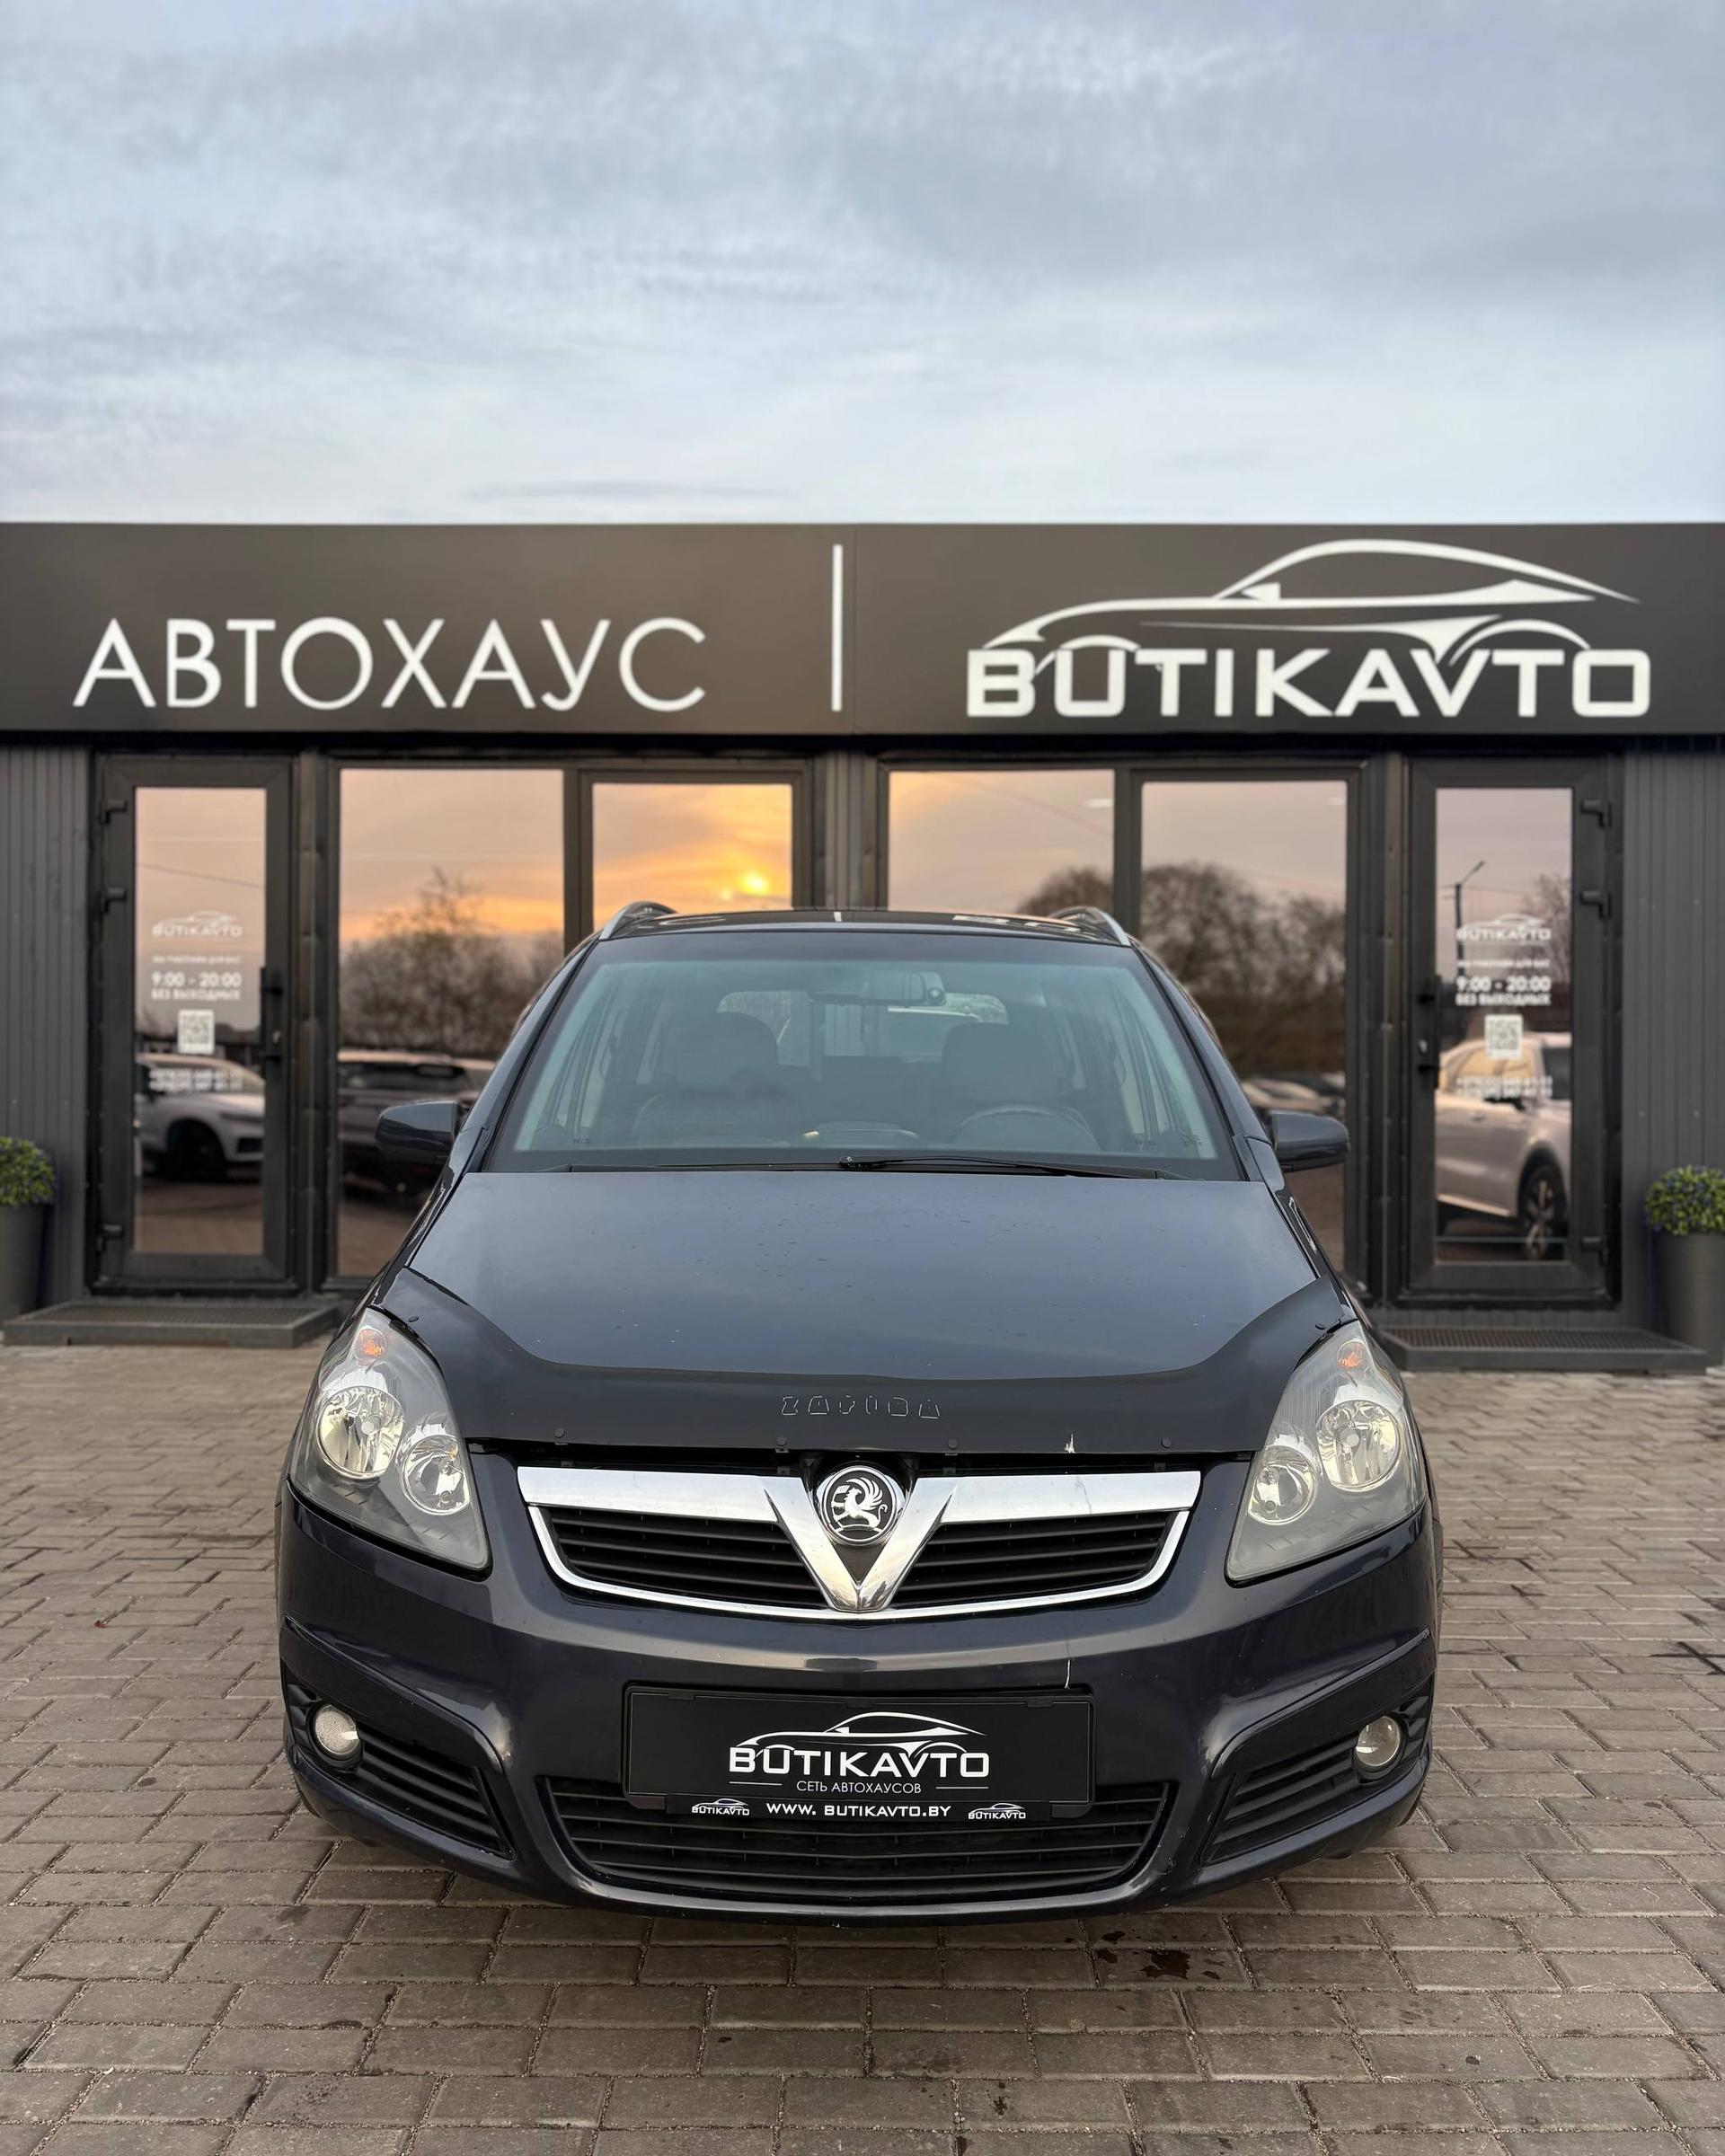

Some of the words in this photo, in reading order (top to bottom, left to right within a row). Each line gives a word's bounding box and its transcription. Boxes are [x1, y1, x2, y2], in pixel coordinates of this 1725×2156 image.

[73, 617, 706, 711] АВТОХАУС
[967, 648, 1650, 718] BUTIKAVTO
[151, 971, 186, 987] 9:00
[199, 971, 243, 987] 20:00
[1456, 976, 1491, 993] 9:00
[1506, 976, 1552, 993] 20:00
[729, 1746, 990, 1778] BUTIKAVTO
[796, 1780, 827, 1792] СЕТЬ
[831, 1781, 922, 1795] АВТОХАУСОВ
[691, 1806, 750, 1816] BUTIKAVTO
[824, 1805, 951, 1817] BUTIKAVTO.BY
[968, 1811, 1026, 1820] BUTIKAVTO
